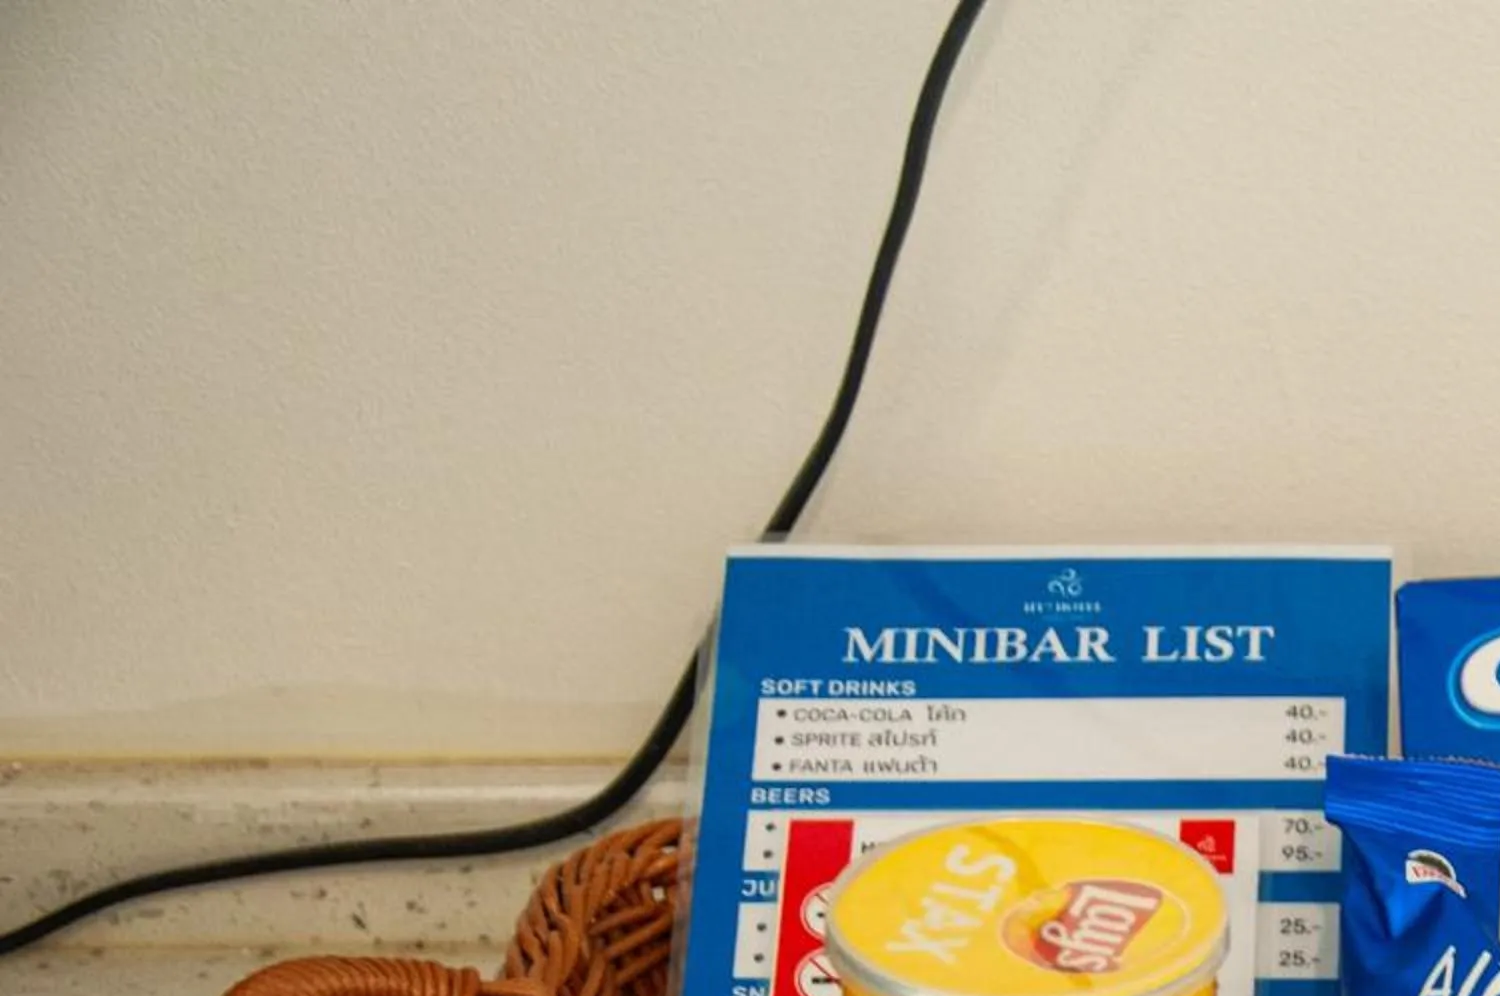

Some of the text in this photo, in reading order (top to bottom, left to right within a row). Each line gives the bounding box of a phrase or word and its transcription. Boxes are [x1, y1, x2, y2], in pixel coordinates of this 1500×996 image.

[842, 625, 1276, 663] MINIBAR LIST
[761, 678, 917, 697] SOFT DRINKS
[793, 707, 913, 722] COCA-COLA
[790, 732, 862, 747] SPRITE
[789, 759, 853, 773] FANTA
[751, 787, 831, 805] BEERS
[885, 844, 1017, 965] STAX
